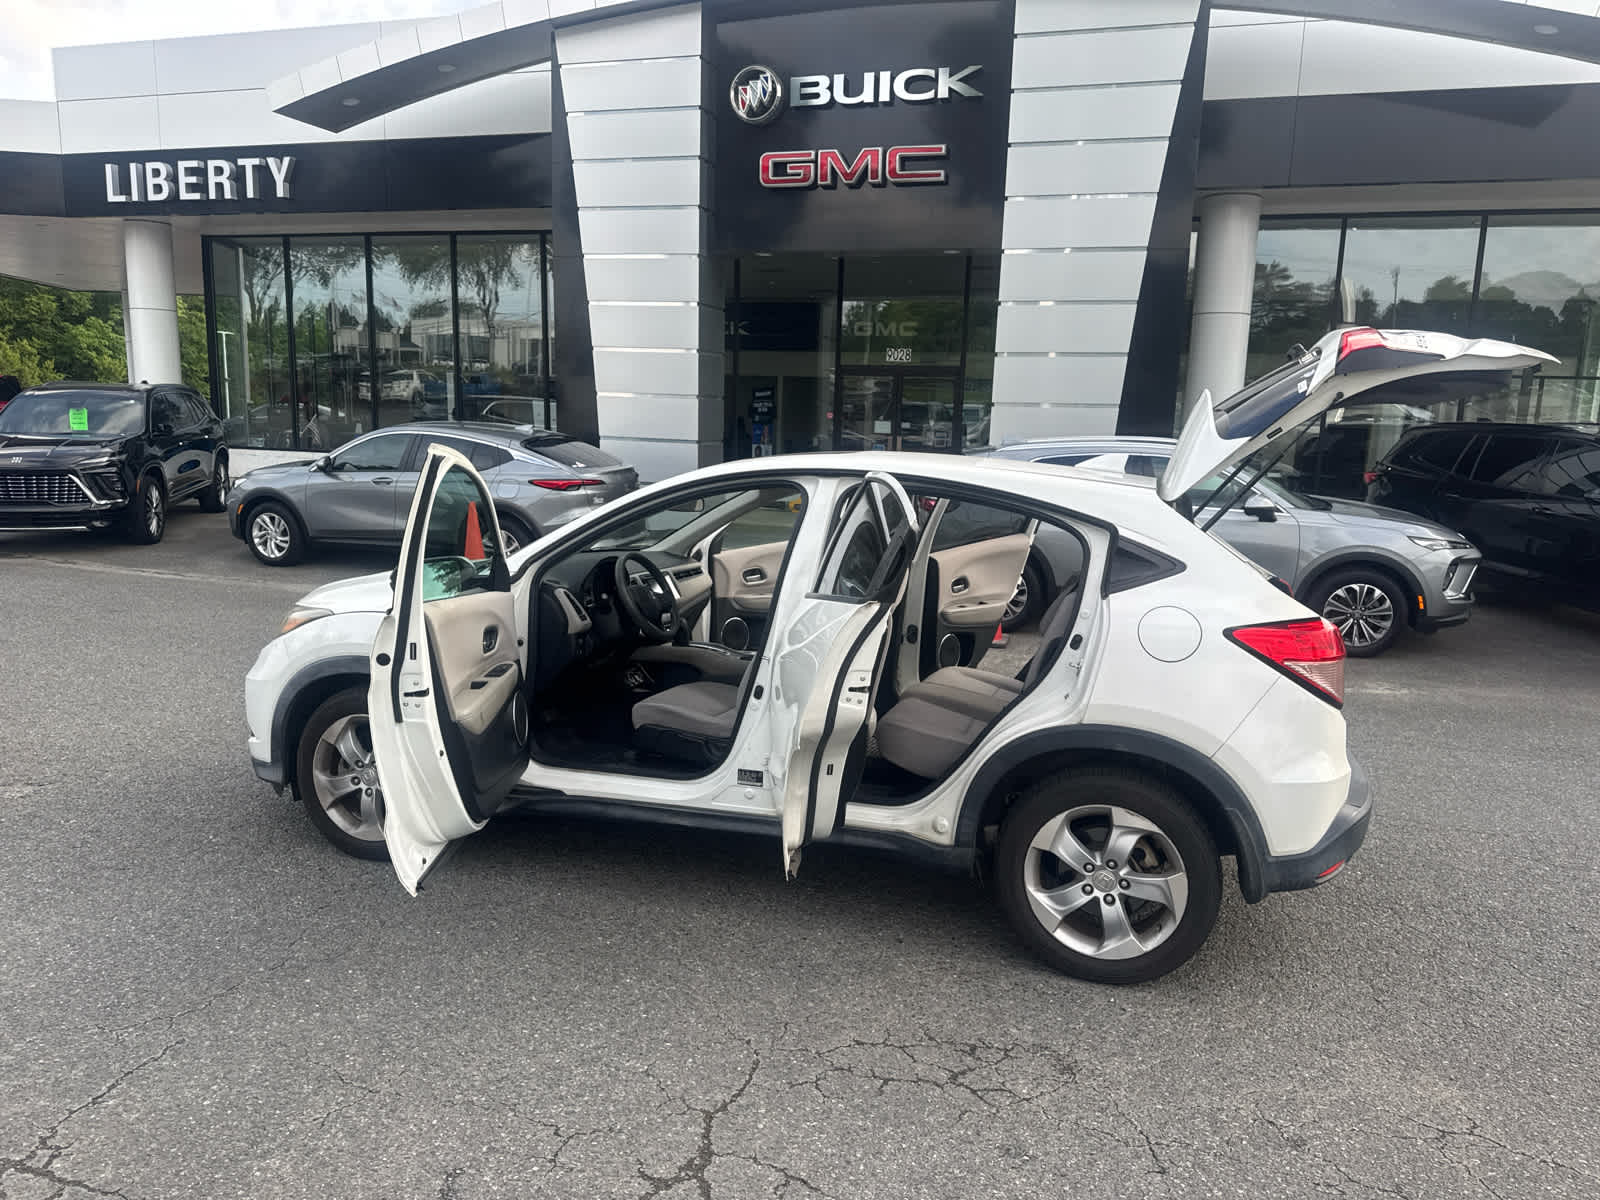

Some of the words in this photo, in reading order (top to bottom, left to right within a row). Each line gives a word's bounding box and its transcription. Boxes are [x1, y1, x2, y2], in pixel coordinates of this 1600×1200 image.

[790, 65, 985, 107] BUICK
[104, 156, 295, 203] LIBERTY
[760, 144, 947, 188] GMC
[854, 321, 918, 337] GMC
[886, 348, 912, 362] 9028
